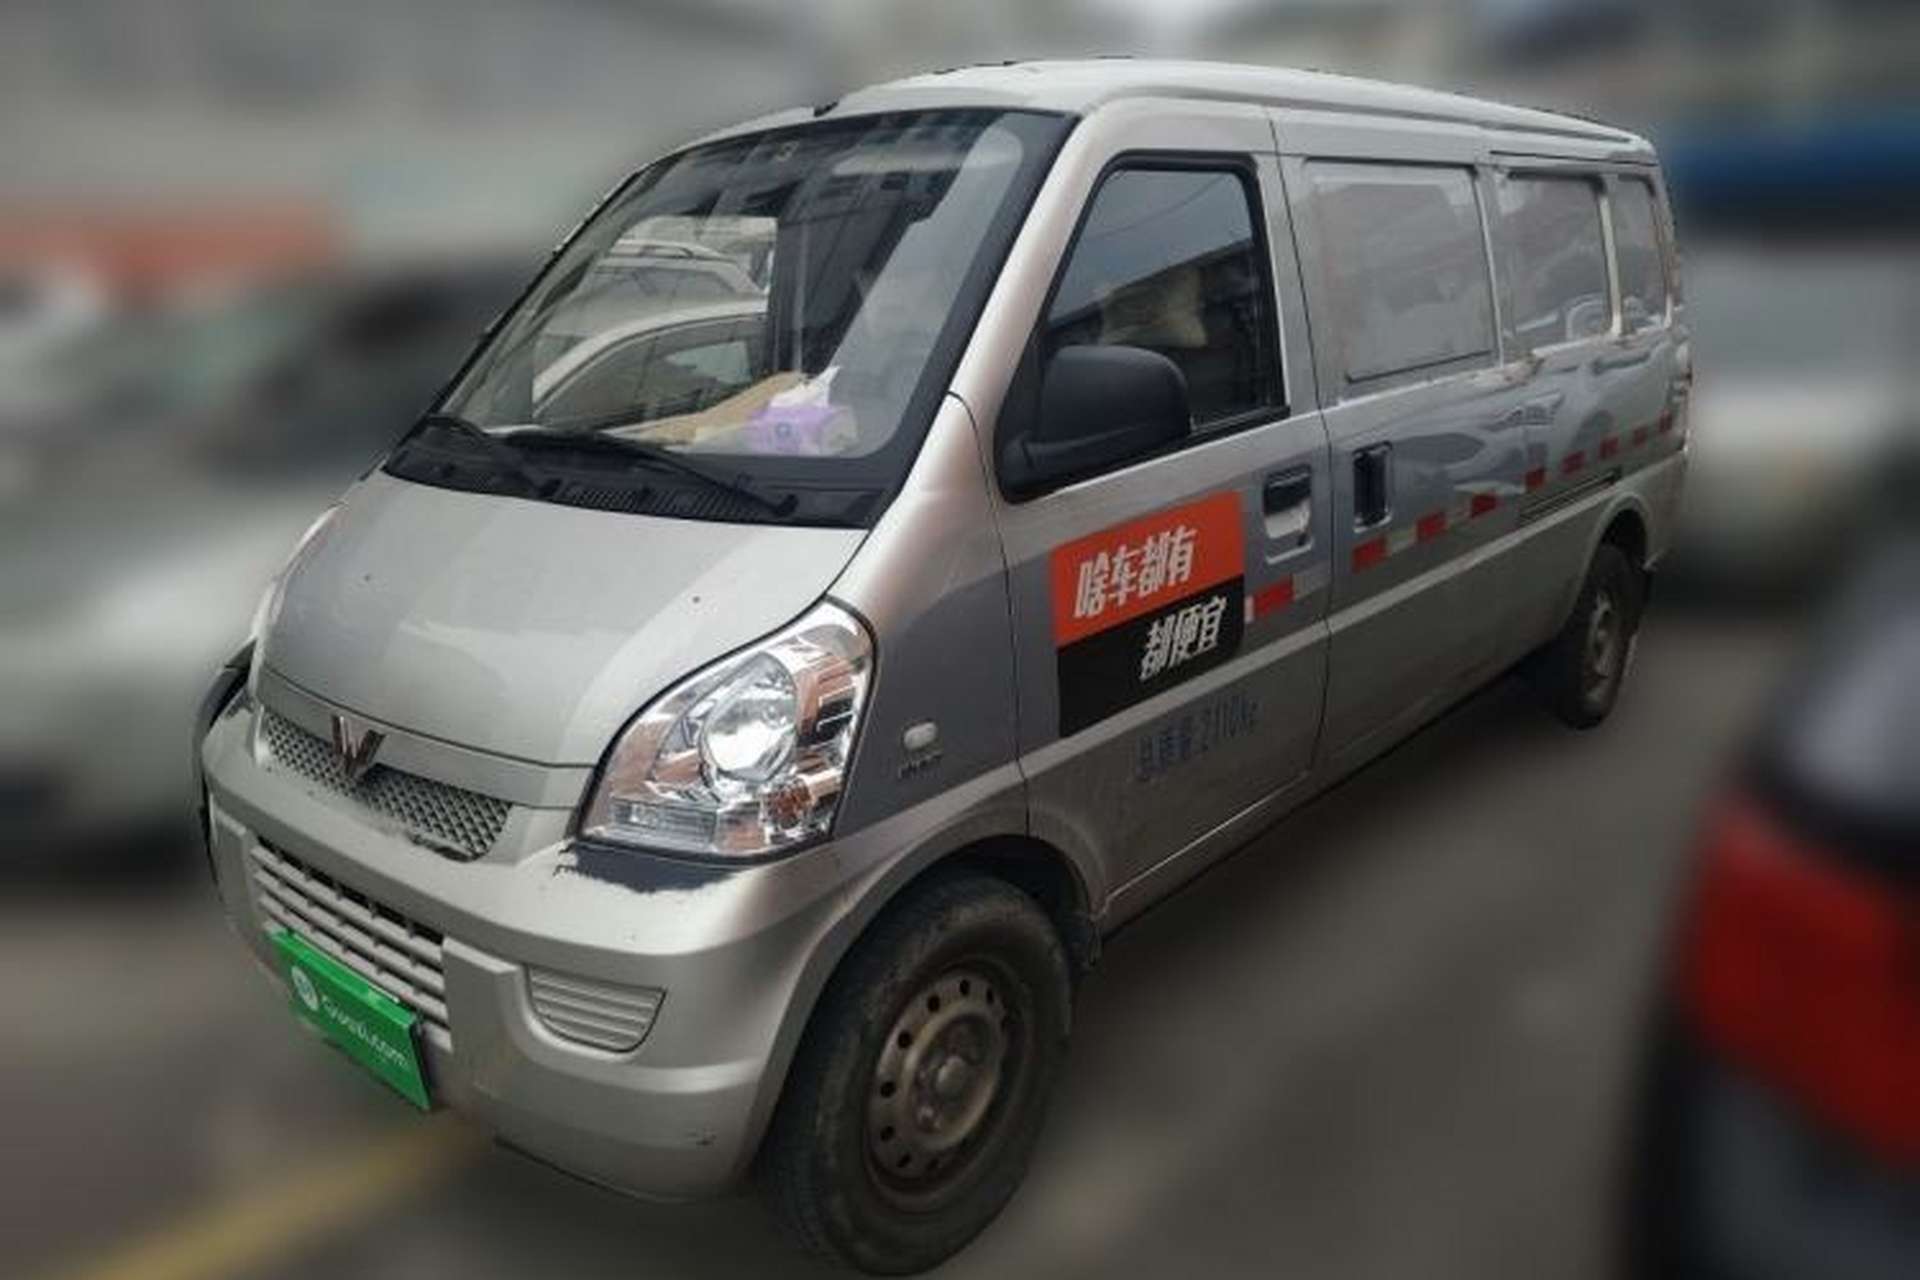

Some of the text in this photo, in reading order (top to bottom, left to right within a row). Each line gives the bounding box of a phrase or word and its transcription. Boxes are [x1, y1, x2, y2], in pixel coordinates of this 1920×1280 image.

[1074, 525, 1198, 618] 啥车都有
[1139, 596, 1228, 681] 都便宜
